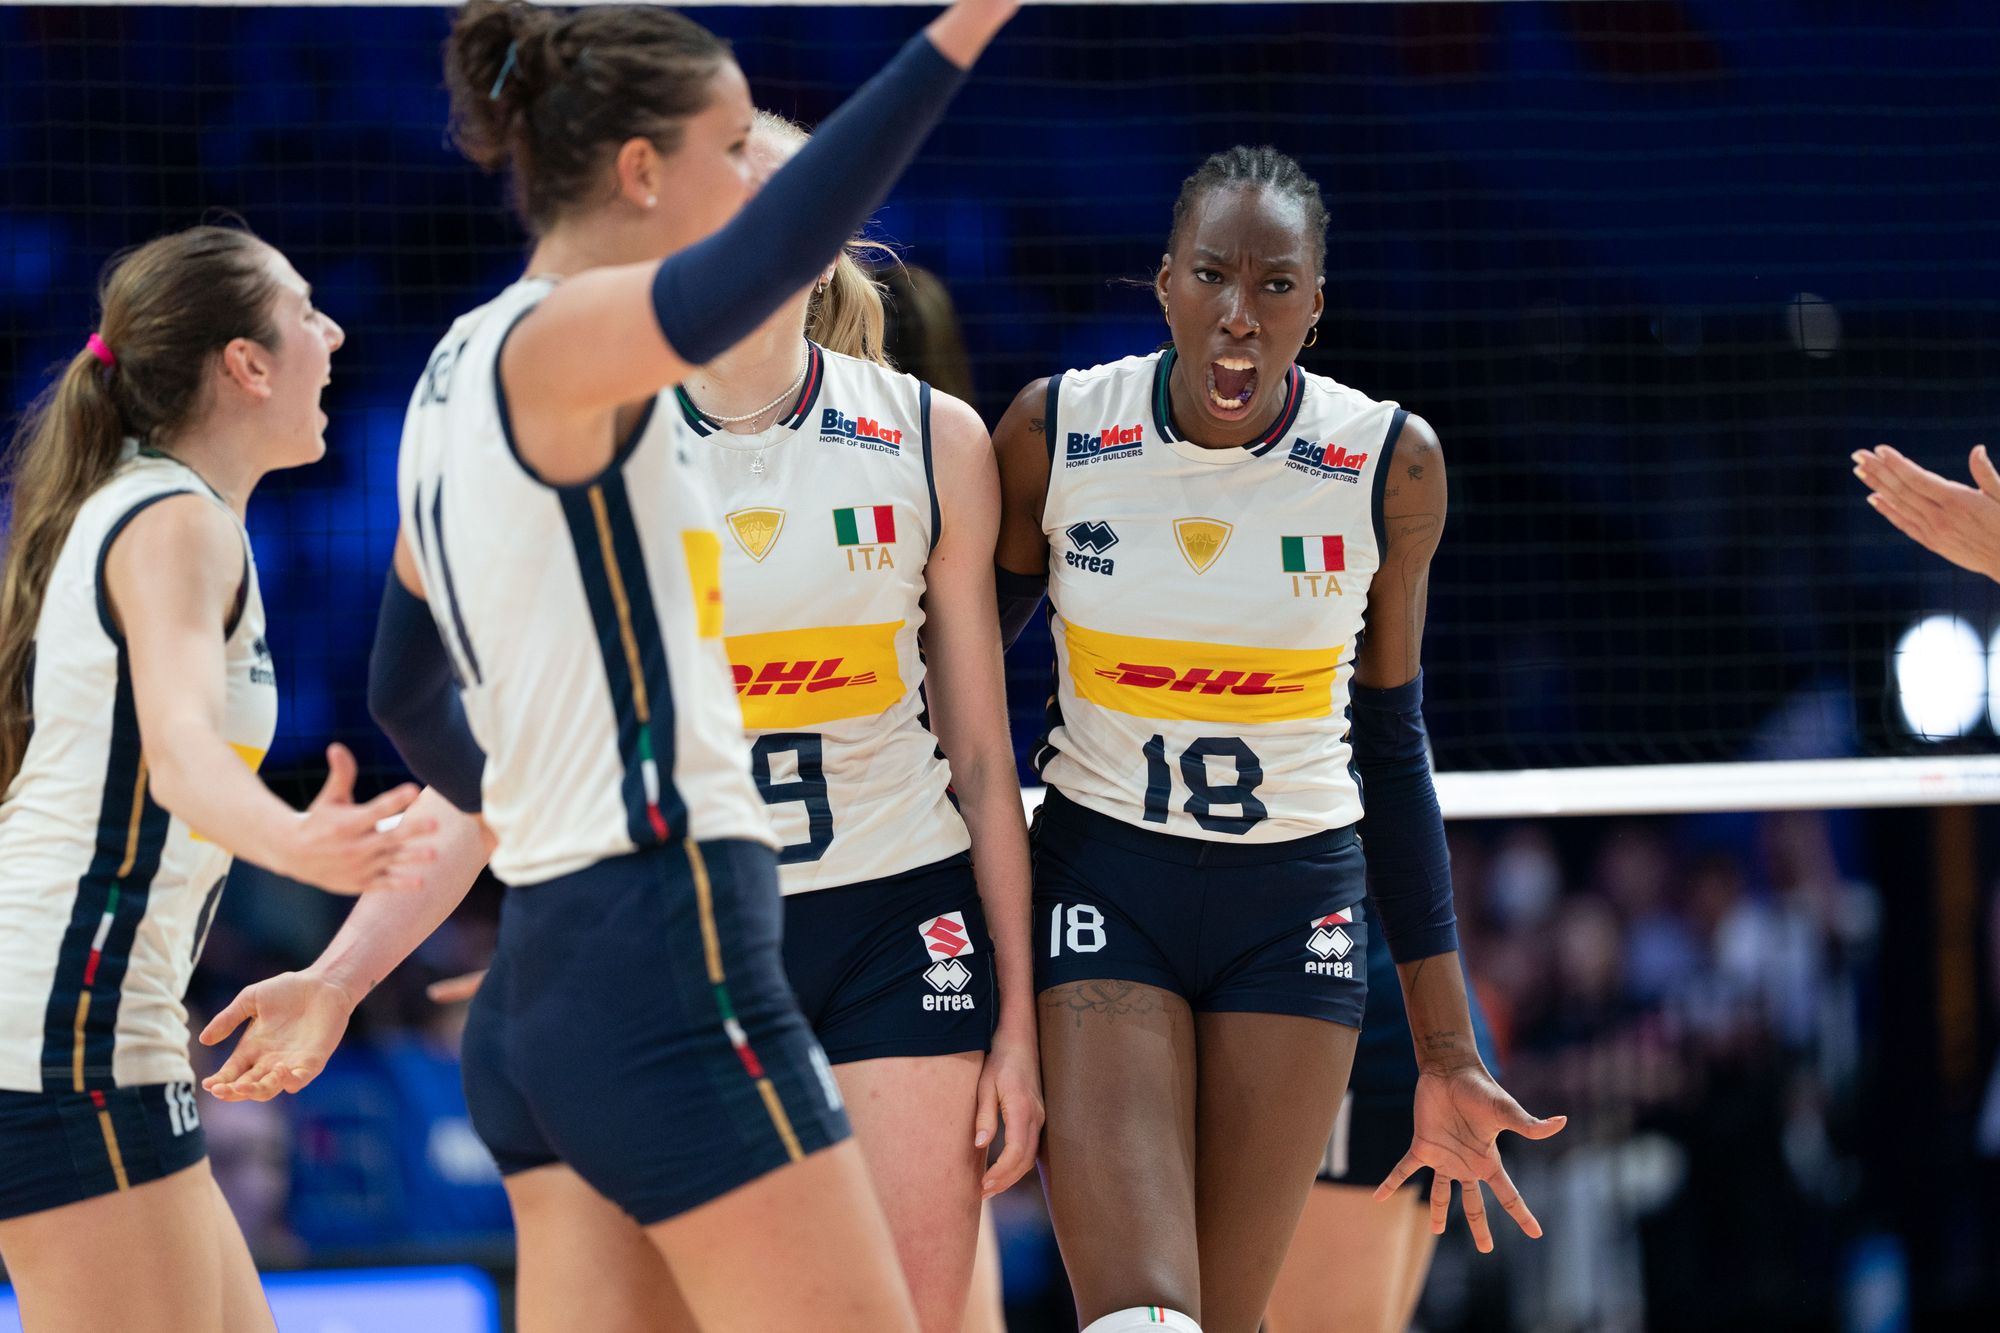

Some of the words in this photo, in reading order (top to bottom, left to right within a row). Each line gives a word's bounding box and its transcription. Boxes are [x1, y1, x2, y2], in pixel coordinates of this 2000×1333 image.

[821, 408, 902, 445] BigMat
[1066, 424, 1143, 456] BigMat
[819, 435, 845, 445] HOME
[847, 439, 858, 447] OF
[860, 442, 900, 457] BUILDERS
[1066, 459, 1089, 468] HOME
[1103, 449, 1143, 462] BUILDERS
[1290, 437, 1368, 470] BigMat
[1284, 460, 1308, 474] HOME
[1310, 468, 1321, 477] OF
[1322, 472, 1358, 484] BUILDERS
[847, 546, 895, 572] ITA
[1292, 574, 1343, 598] ITA
[1116, 662, 1277, 695] DHL
[750, 732, 835, 866] 9
[1142, 734, 1268, 835] 18
[1050, 903, 1107, 958] 18
